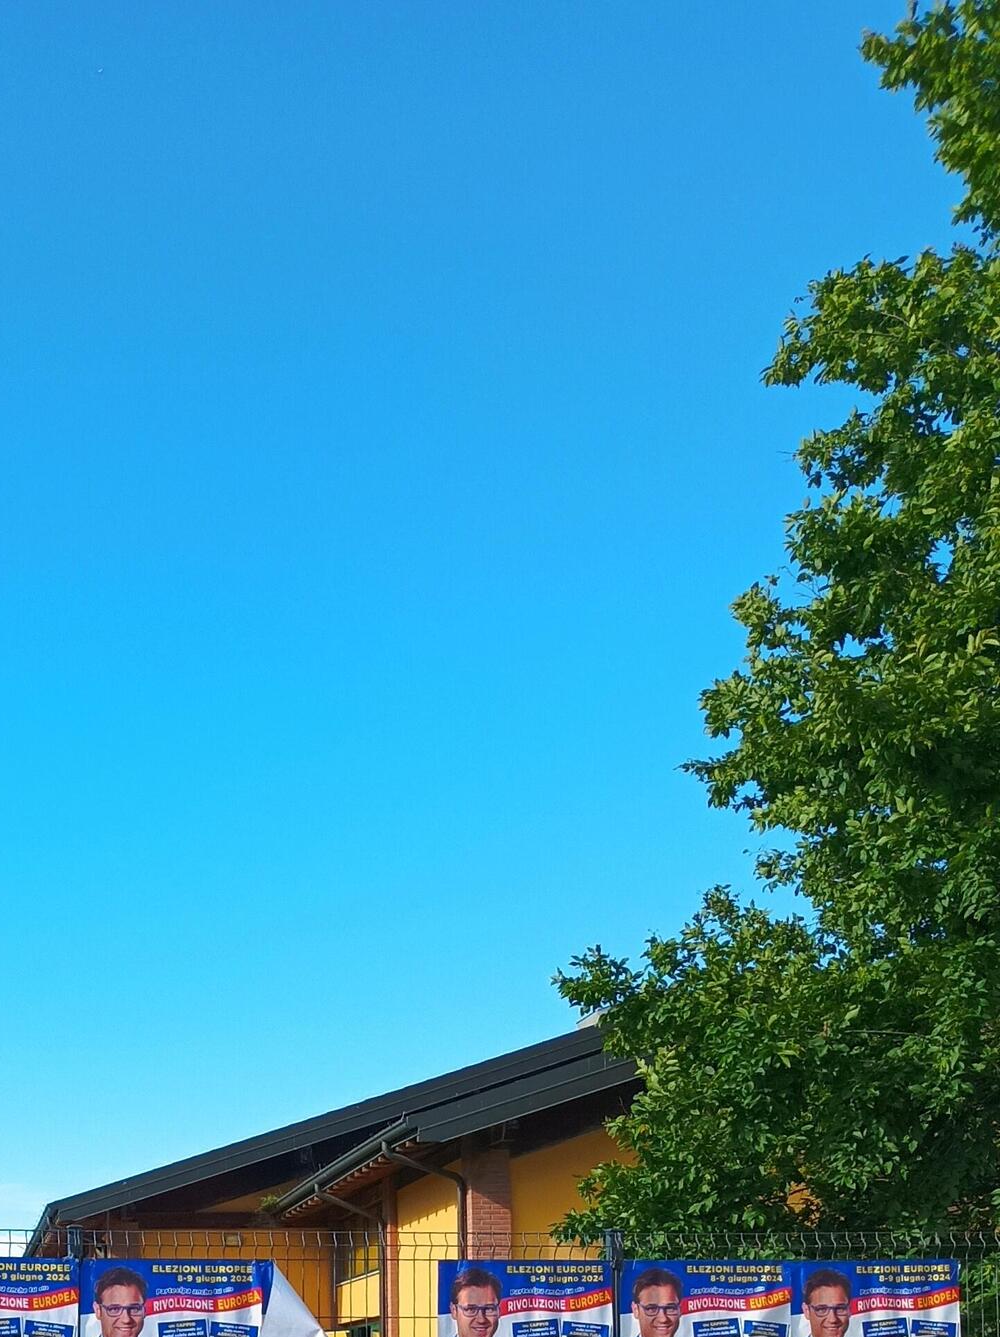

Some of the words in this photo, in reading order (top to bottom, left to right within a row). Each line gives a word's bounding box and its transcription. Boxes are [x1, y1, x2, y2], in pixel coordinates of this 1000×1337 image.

[20, 1264, 70, 1272] EUROPEE
[152, 1265, 201, 1273] ELEZIONI
[205, 1265, 254, 1273] EUROPEE
[506, 1266, 553, 1274] ELEZIONI
[557, 1265, 605, 1273] EUROPEE
[687, 1265, 733, 1273] ELEZIONI
[737, 1265, 783, 1273] EUROPEE
[856, 1266, 901, 1274] ELEZIONI
[904, 1265, 950, 1273] EUROPEE
[10, 1273, 43, 1281] giugno
[195, 1275, 227, 1283] giugno
[548, 1275, 579, 1283] giugno
[728, 1275, 758, 1283] giugno
[896, 1275, 926, 1283] giugno
[33, 1289, 76, 1308] EUROPEA
[153, 1298, 214, 1311] RIVOLUZIONE
[218, 1291, 259, 1309] EUROPEA
[507, 1298, 566, 1311] RIVOLUZIONE
[570, 1290, 610, 1309] EUROPEA
[688, 1298, 746, 1310] RIVOLUZIONE
[750, 1290, 790, 1308] EUROPEA
[857, 1298, 914, 1310] RIVOLUZIONE
[918, 1289, 956, 1307] EUROPEA
